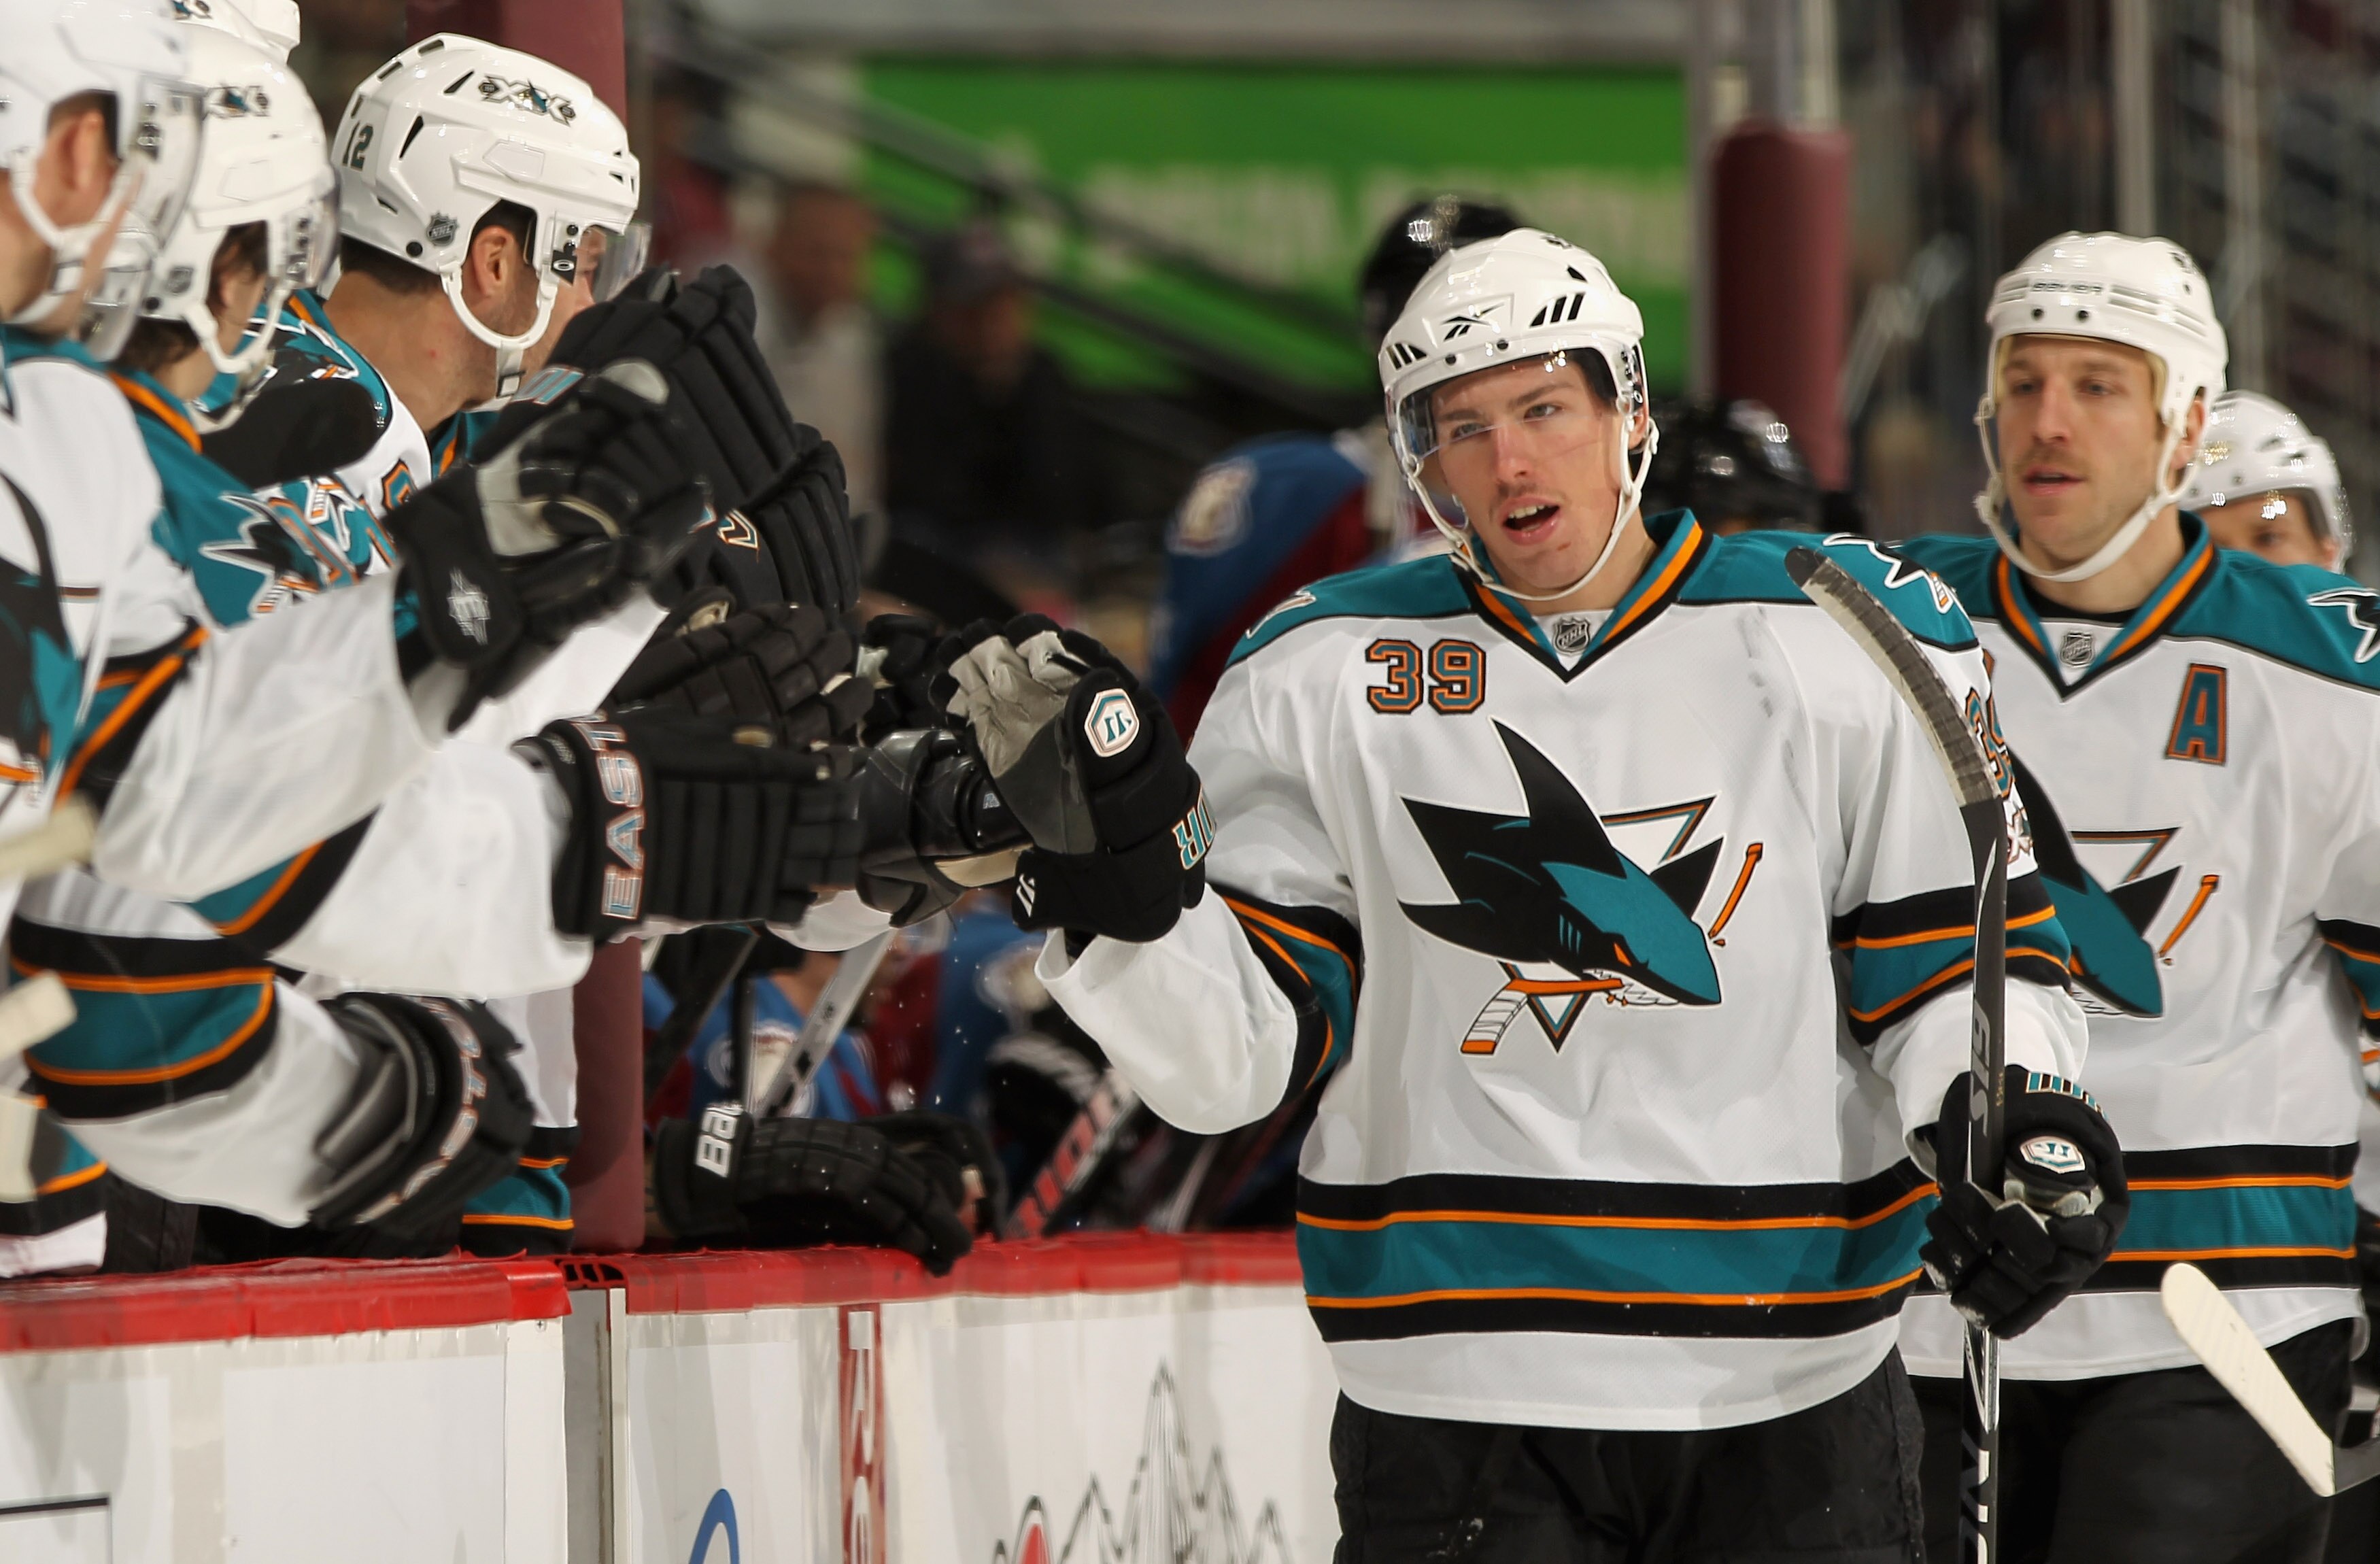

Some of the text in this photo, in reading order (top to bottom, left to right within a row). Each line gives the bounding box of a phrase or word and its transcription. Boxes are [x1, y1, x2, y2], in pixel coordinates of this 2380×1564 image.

[342, 120, 373, 171] 12
[1365, 638, 1486, 715] 39
[2164, 663, 2227, 767] A
[573, 709, 647, 920] EAST
